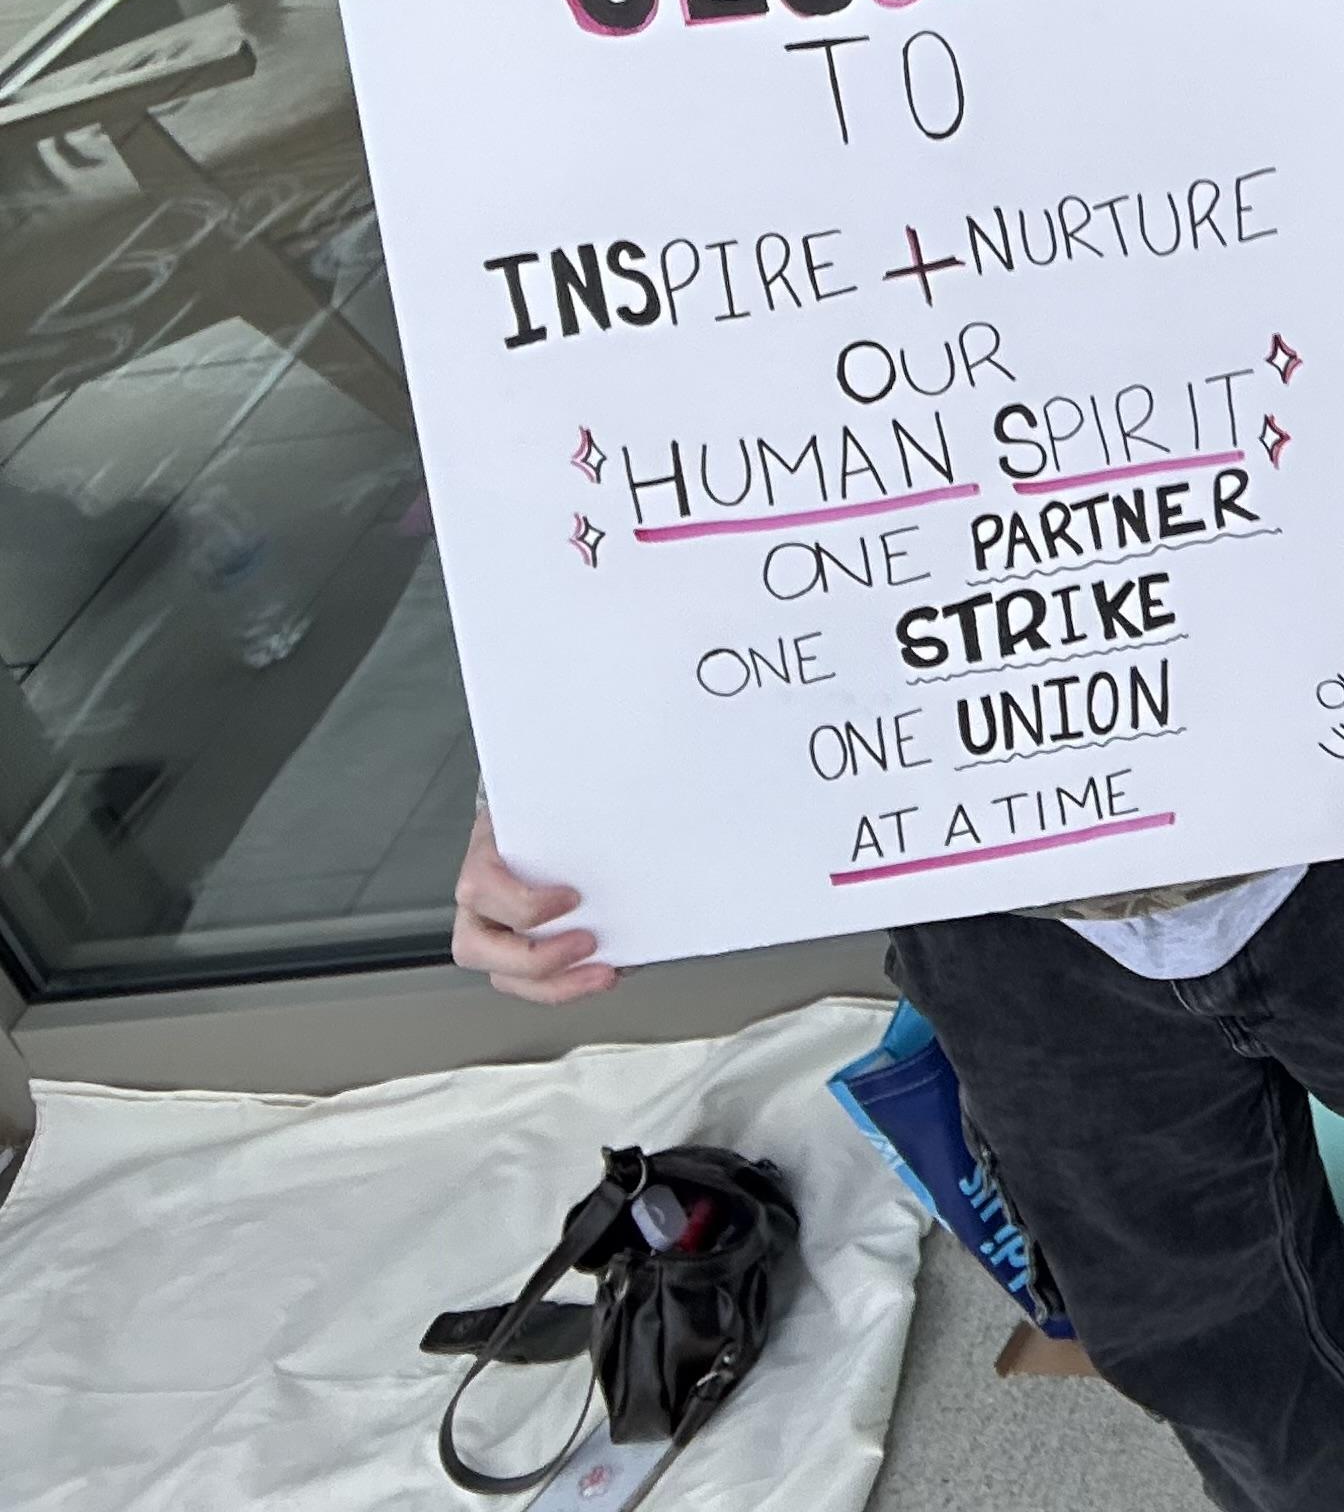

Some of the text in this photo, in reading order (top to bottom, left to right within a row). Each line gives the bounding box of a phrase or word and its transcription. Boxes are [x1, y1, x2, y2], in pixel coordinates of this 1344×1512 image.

[784, 31, 965, 145] TO
[484, 230, 858, 349] INSPIRE
[965, 168, 1279, 275] NURTURE
[836, 323, 1017, 404] OUR
[622, 368, 1254, 525] HUMAN SPIRIT
[762, 468, 1261, 601] ONE PARTNER
[696, 572, 1177, 698] ONE STRIKE
[809, 659, 1171, 781] ONE UNION
[851, 768, 1139, 862] AT A TIME
